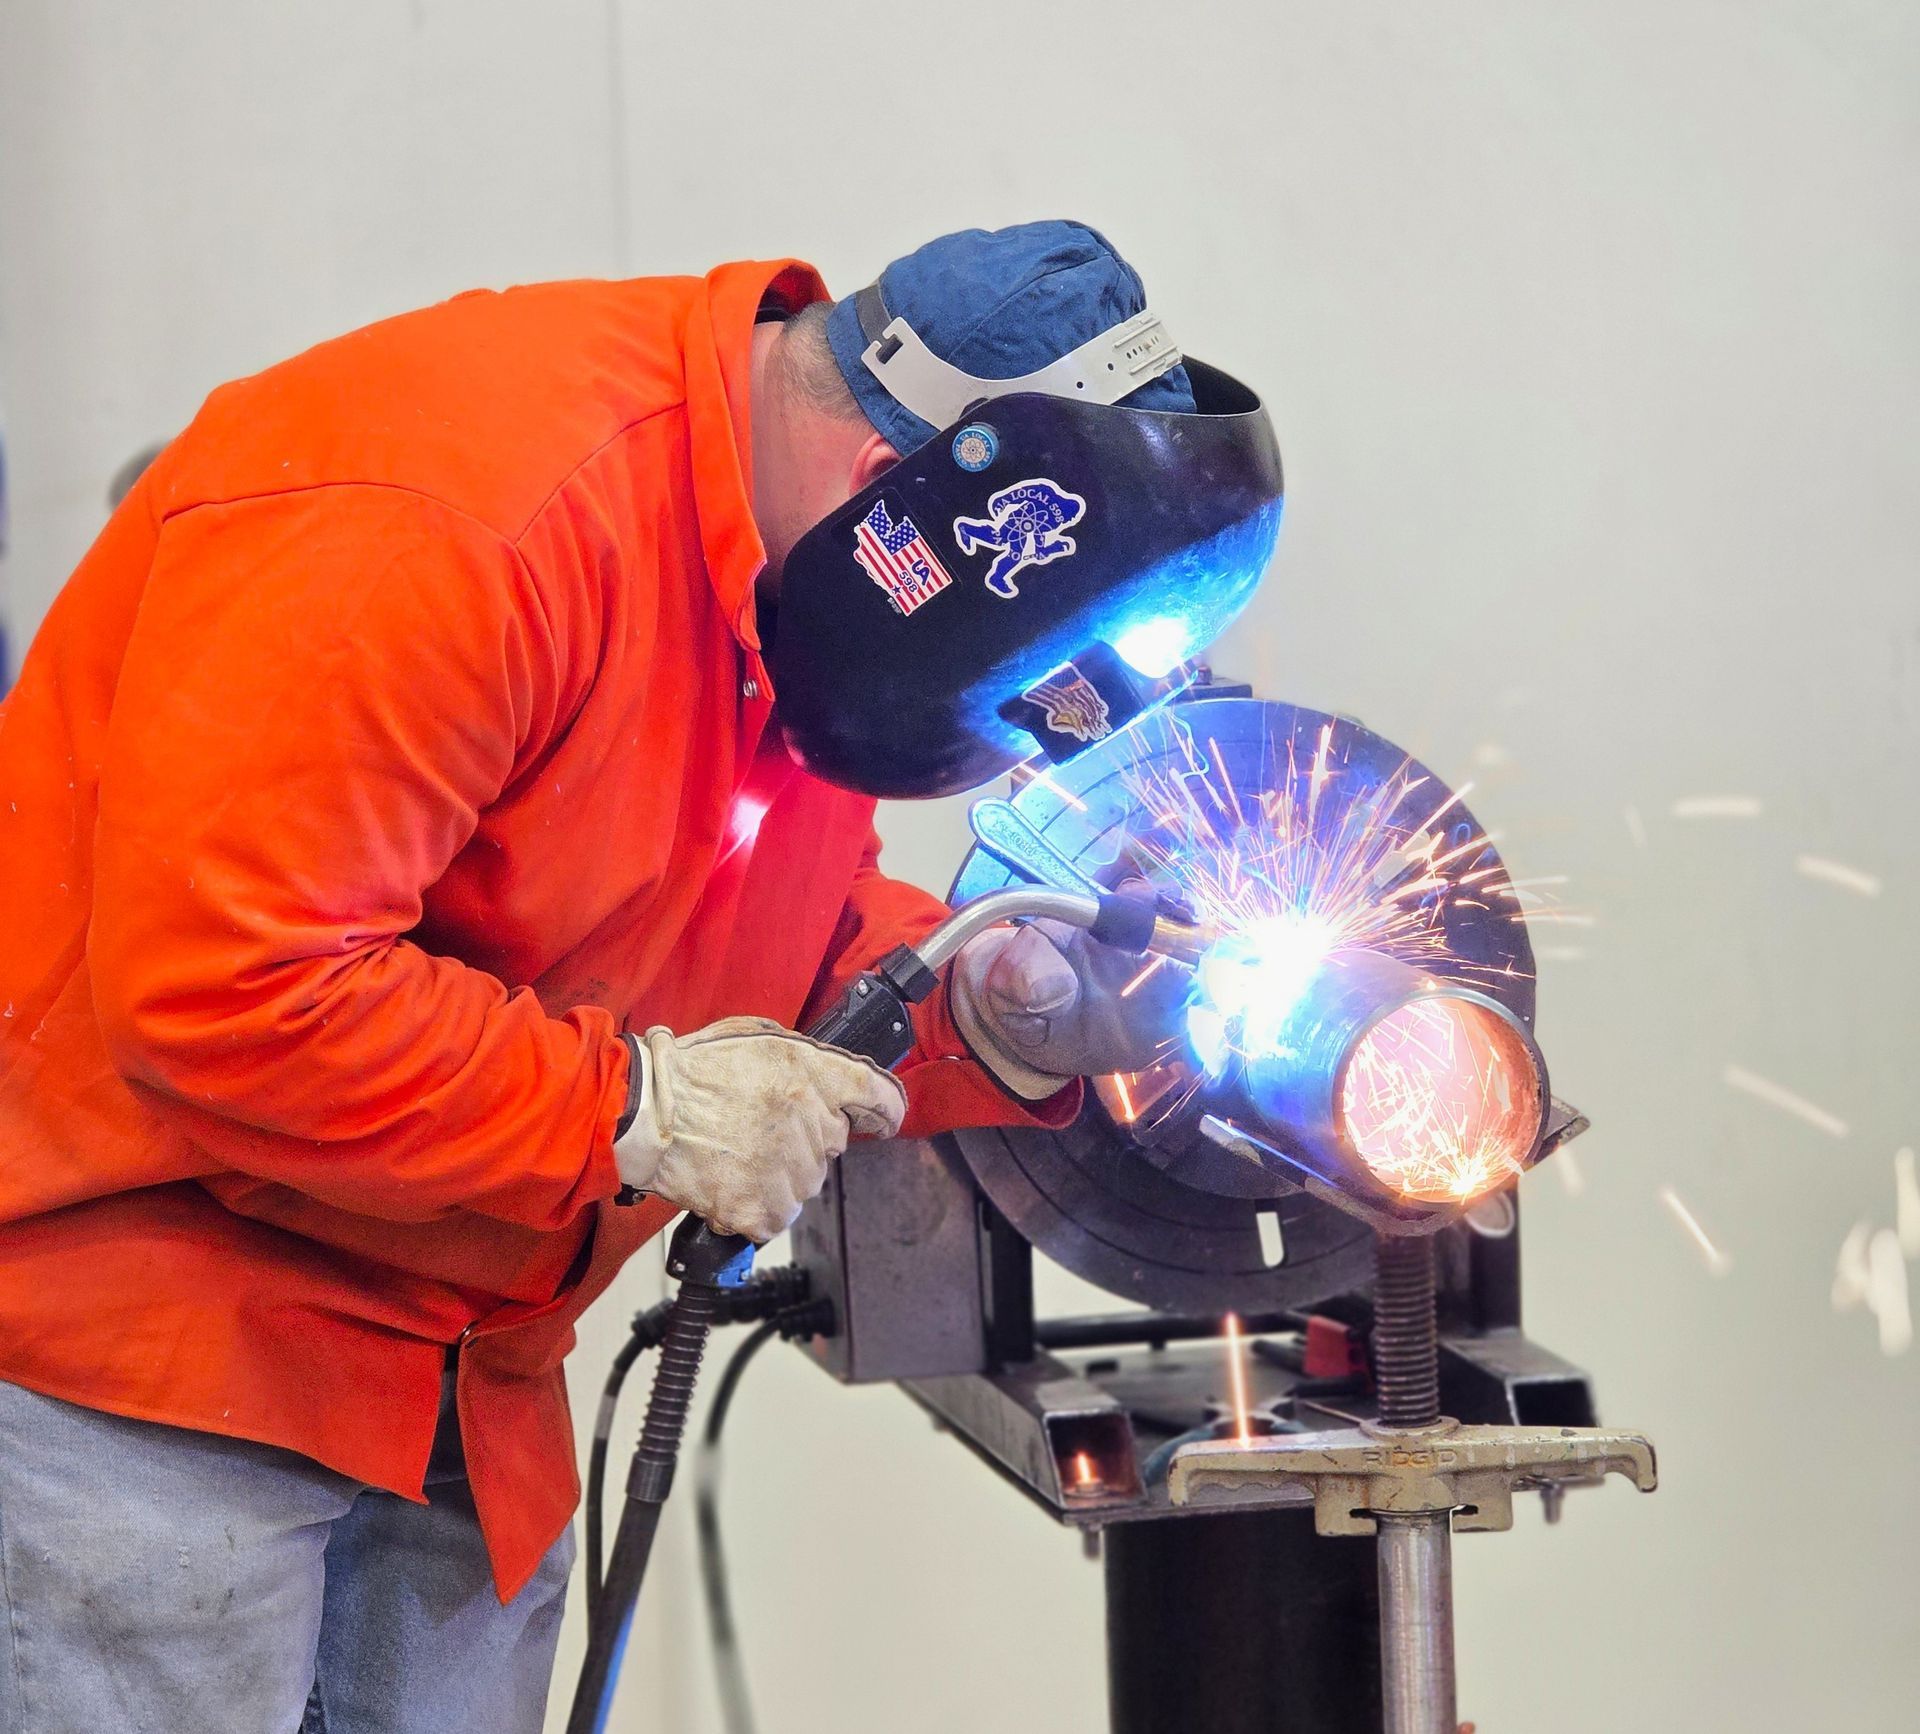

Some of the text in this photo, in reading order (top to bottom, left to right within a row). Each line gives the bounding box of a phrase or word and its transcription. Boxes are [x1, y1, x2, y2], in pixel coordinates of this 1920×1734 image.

[971, 432, 990, 449] LOCAL
[994, 489, 1065, 524] UA LOCAL 598
[899, 571, 918, 593] 598
[911, 558, 932, 587] UA
[1361, 1447, 1458, 1467] RIDGID
